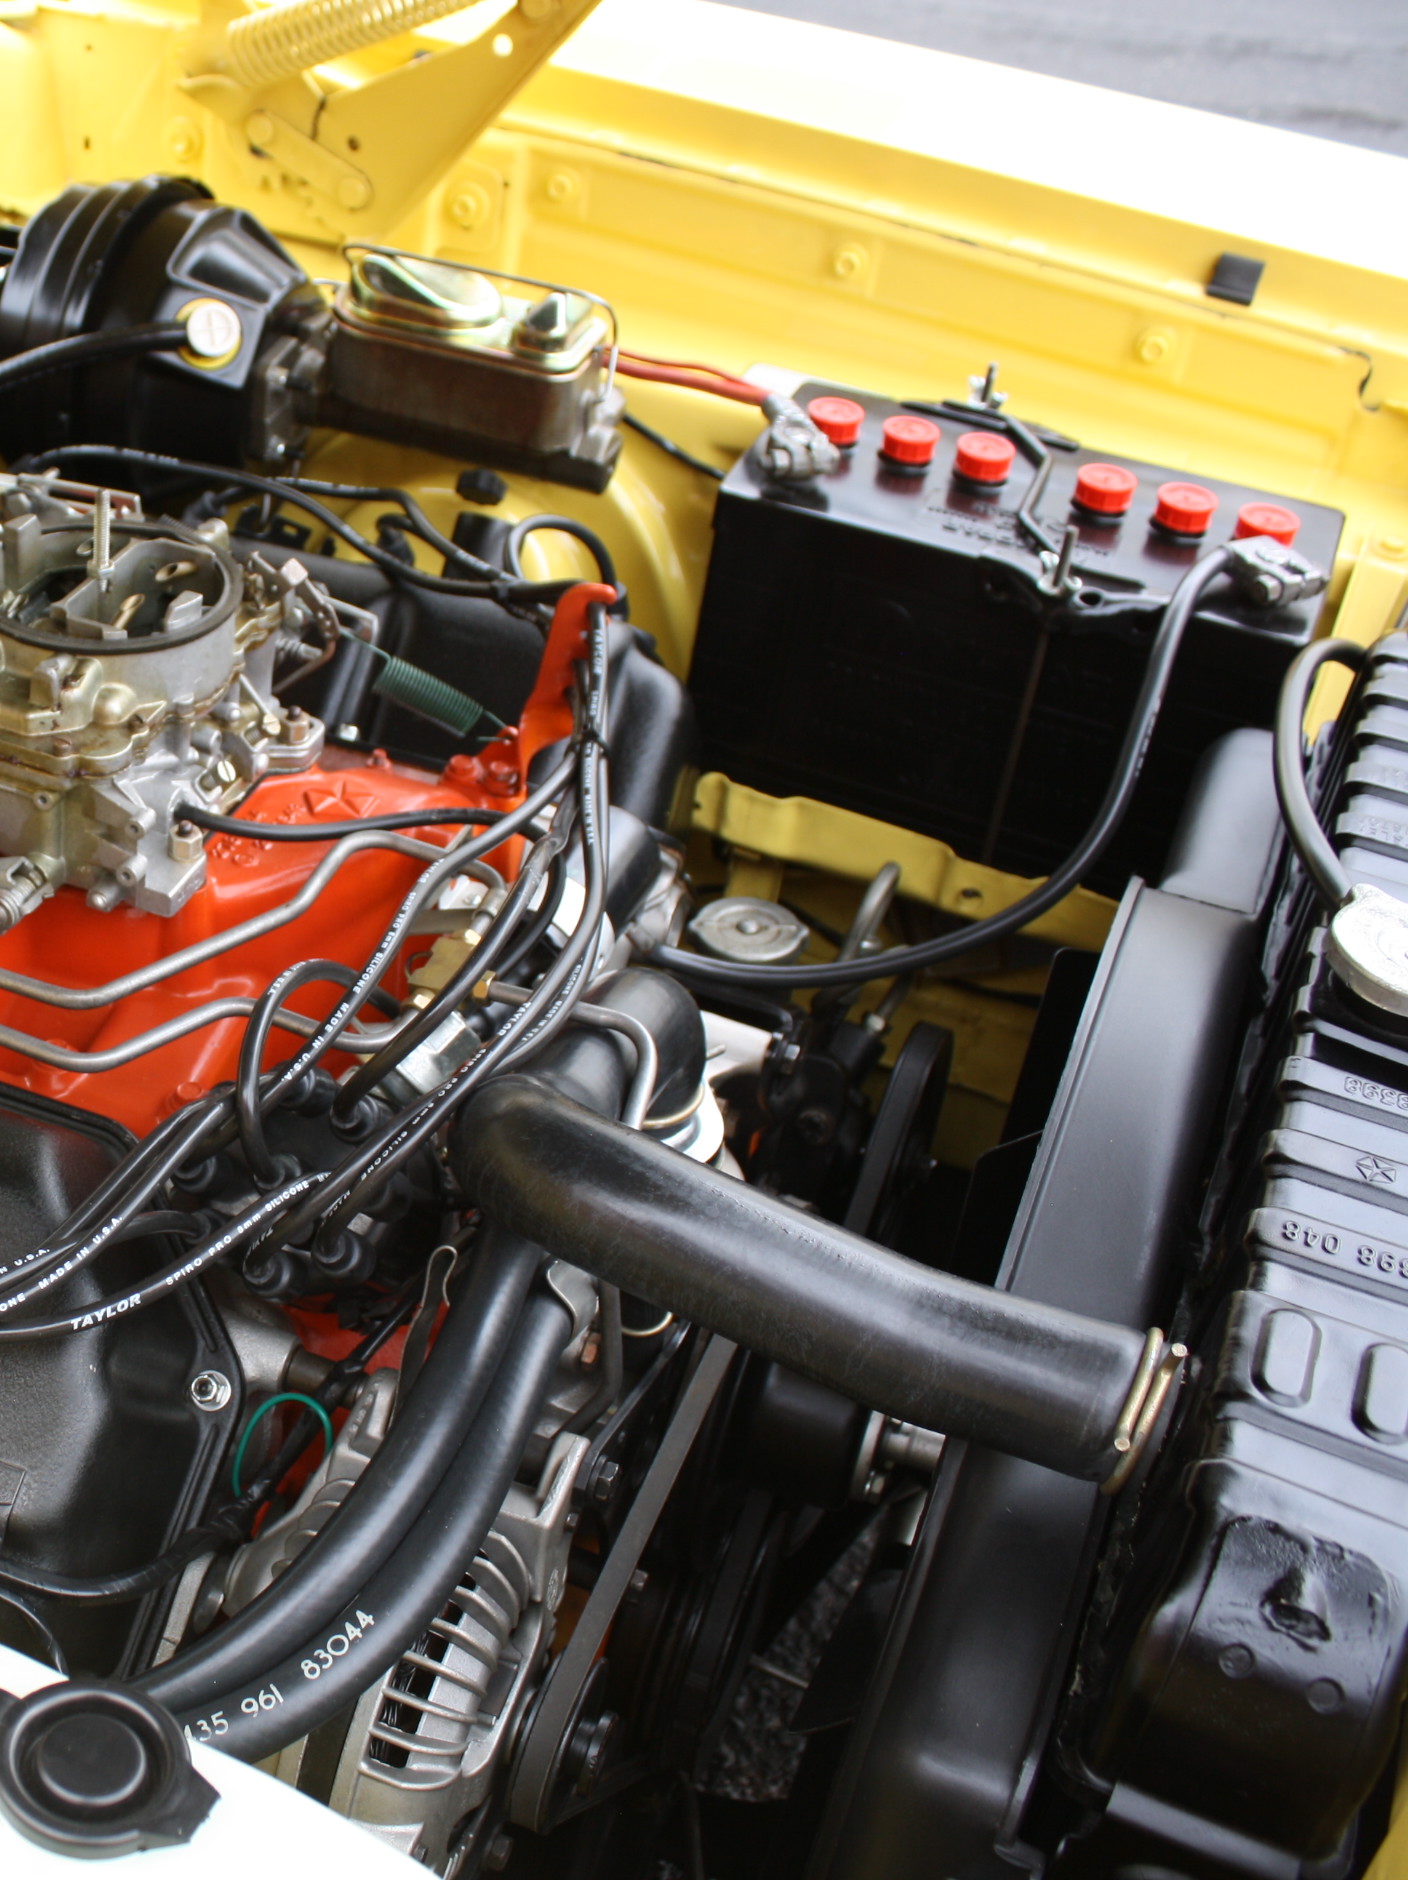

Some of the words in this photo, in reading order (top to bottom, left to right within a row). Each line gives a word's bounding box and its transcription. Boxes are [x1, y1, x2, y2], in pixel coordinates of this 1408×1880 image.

[352, 952, 384, 995] SILICONE
[325, 1002, 350, 1033] MADE
[497, 1001, 532, 1037] TAYLOR
[312, 1036, 325, 1049] IN
[38, 1260, 73, 1289] MADE
[76, 1246, 90, 1261] IN
[71, 1293, 141, 1330] TAYLOR
[165, 1257, 203, 1286] SPIRO
[208, 1234, 232, 1257] PRO
[264, 1180, 310, 1212] SILICONE
[241, 1683, 285, 1718] 961
[300, 1609, 375, 1680] 83044
